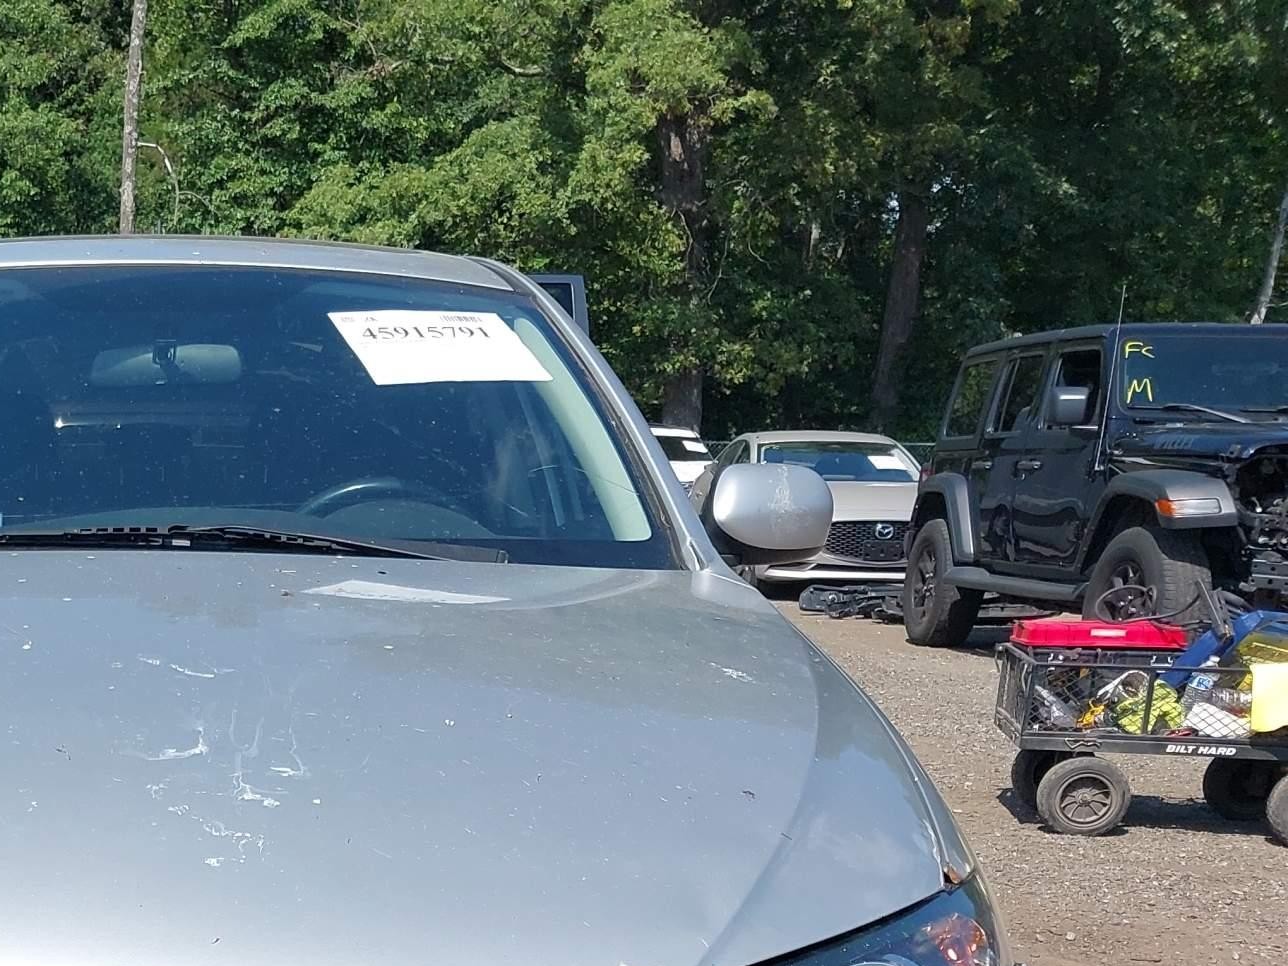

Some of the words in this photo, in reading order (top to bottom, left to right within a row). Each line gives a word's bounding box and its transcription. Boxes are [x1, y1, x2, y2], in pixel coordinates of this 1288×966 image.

[362, 326, 491, 340] 45915791
[1126, 377, 1153, 404] M
[1165, 744, 1196, 754] BILT
[1197, 746, 1237, 756] HARD
